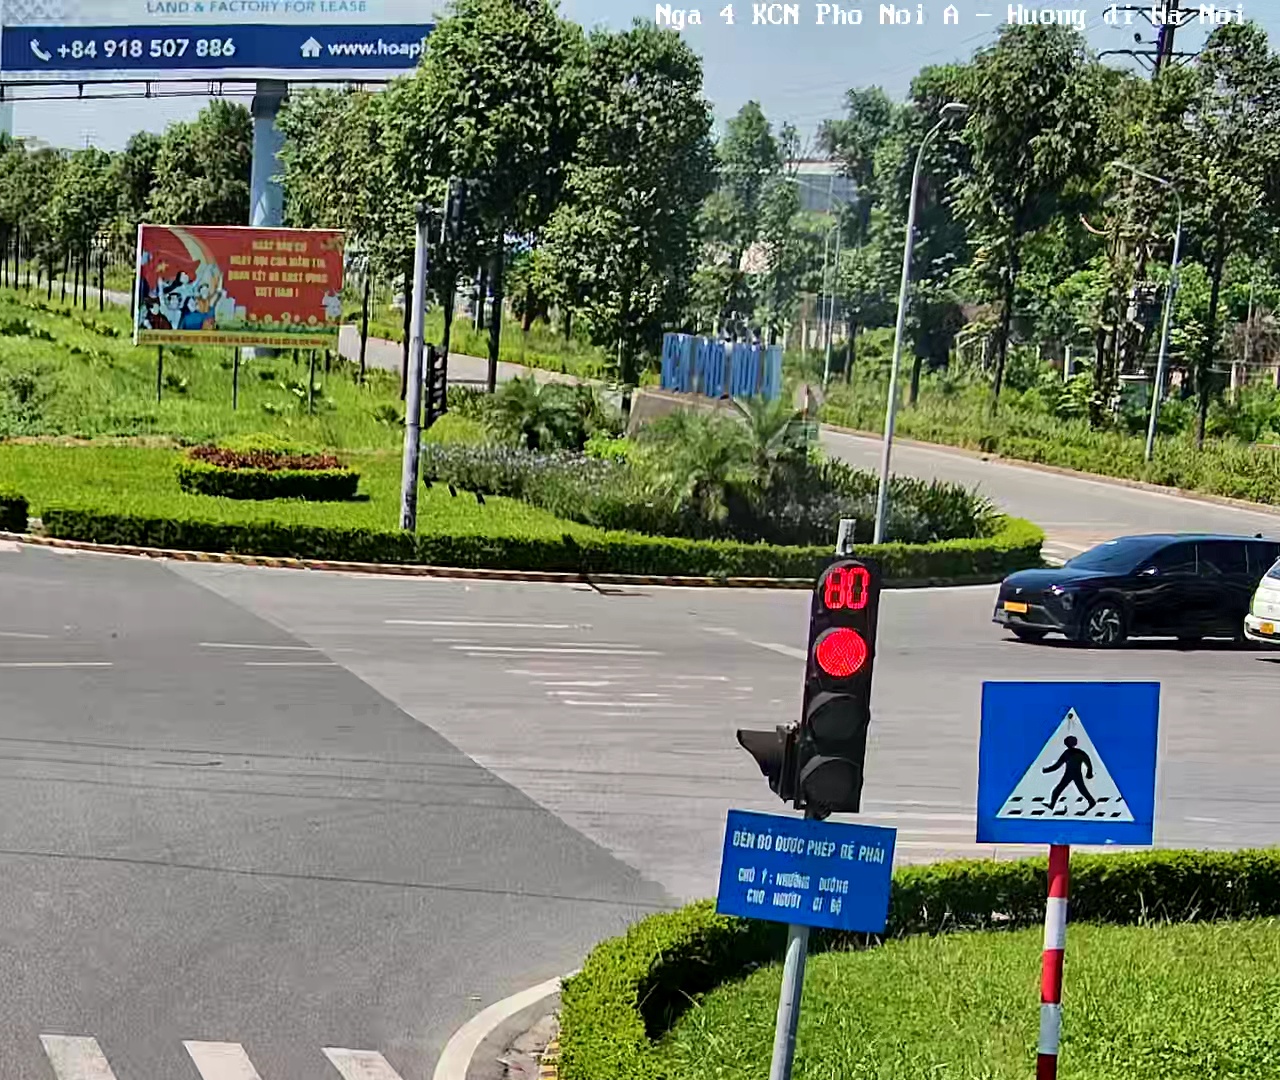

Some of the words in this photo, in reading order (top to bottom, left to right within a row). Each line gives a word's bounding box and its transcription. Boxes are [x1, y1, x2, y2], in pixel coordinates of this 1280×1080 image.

[147, 1, 189, 13] LAND
[194, 1, 205, 13] &
[210, 0, 277, 13] FACTORY
[285, 0, 315, 13] FOR
[321, 0, 366, 12] LEASE
[57, 40, 98, 59] +84
[104, 39, 143, 58] 918
[149, 38, 189, 58] 507
[196, 38, 236, 57] 886
[824, 567, 871, 609] 80
